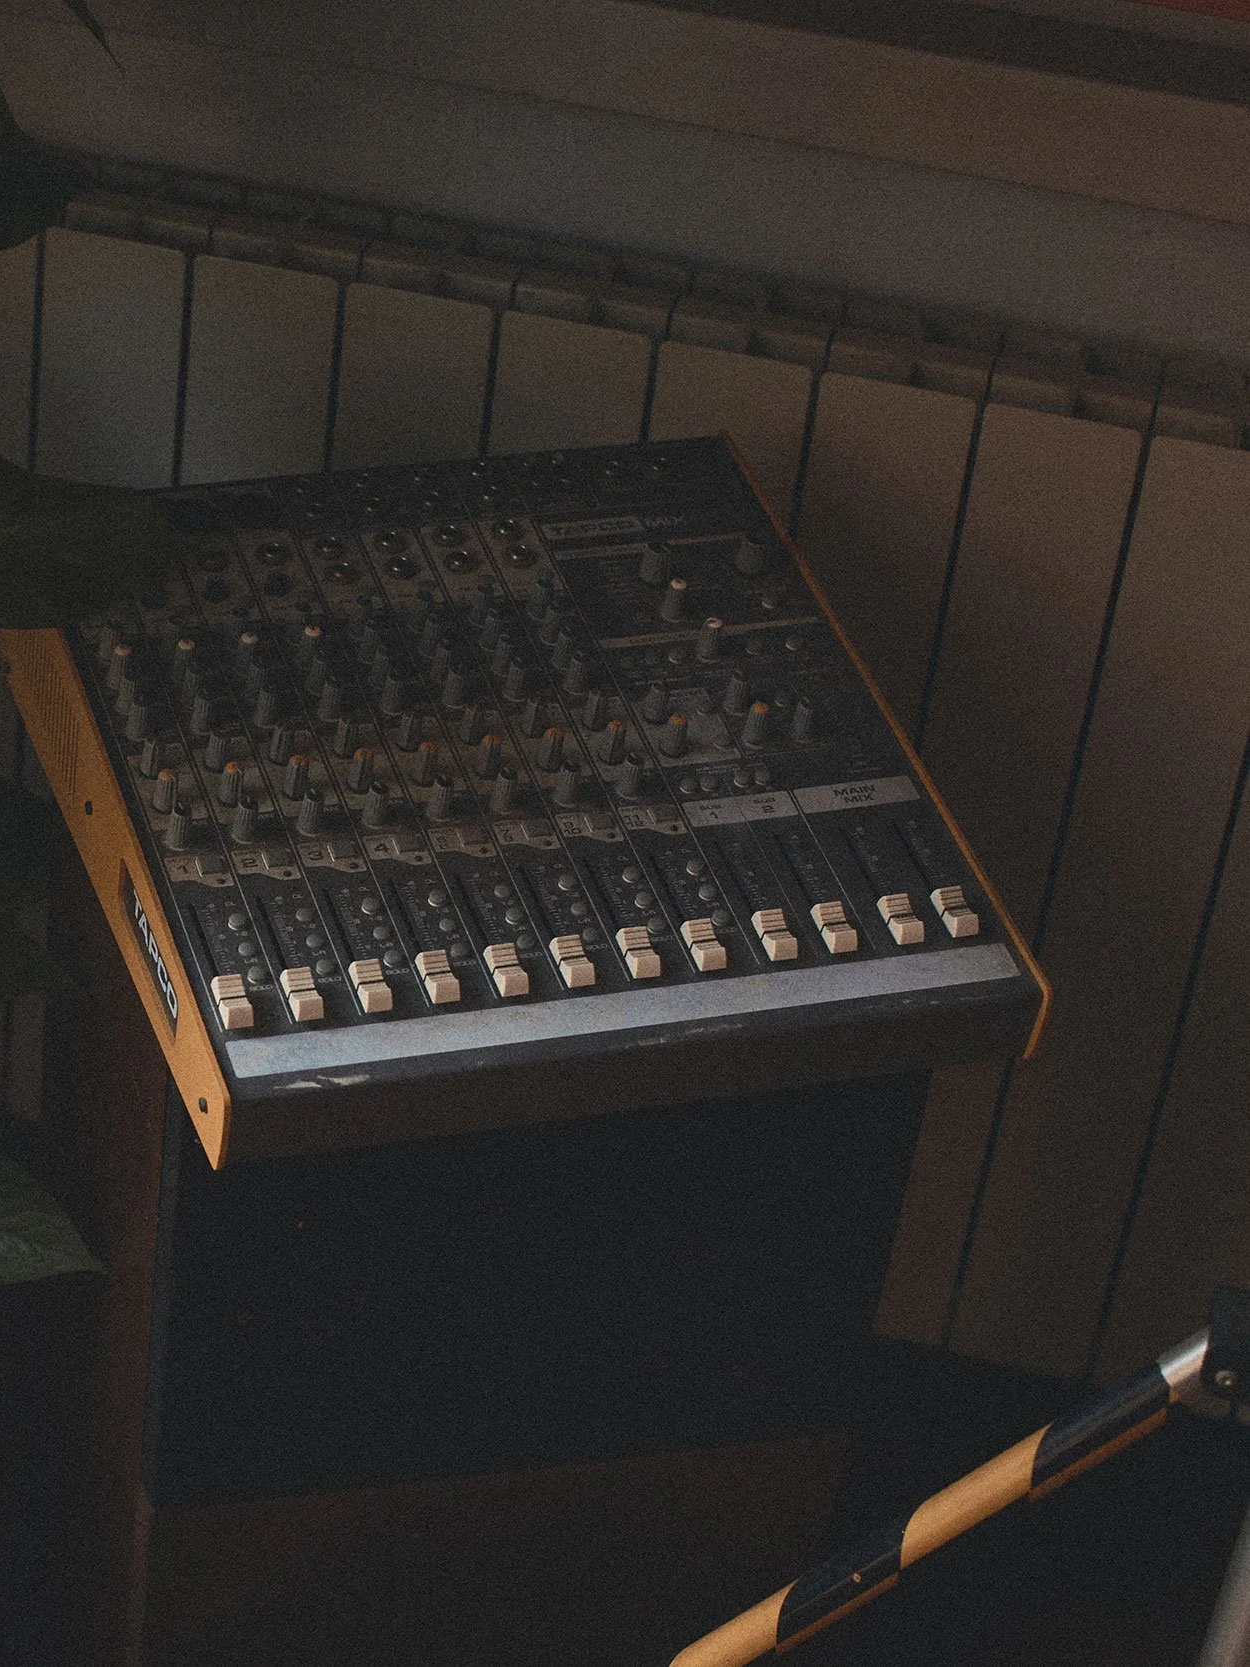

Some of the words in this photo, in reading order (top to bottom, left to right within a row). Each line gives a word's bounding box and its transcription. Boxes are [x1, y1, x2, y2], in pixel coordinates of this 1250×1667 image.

[549, 519, 634, 536] TAPCO
[833, 784, 876, 797] MAIN
[844, 793, 875, 804] MIX
[699, 803, 722, 811] SUB
[762, 805, 775, 813] 2
[374, 843, 389, 853] 4
[307, 850, 324, 861] 3
[241, 858, 258, 868] 2
[177, 864, 188, 874] 1
[133, 889, 178, 1018] TAPCO
